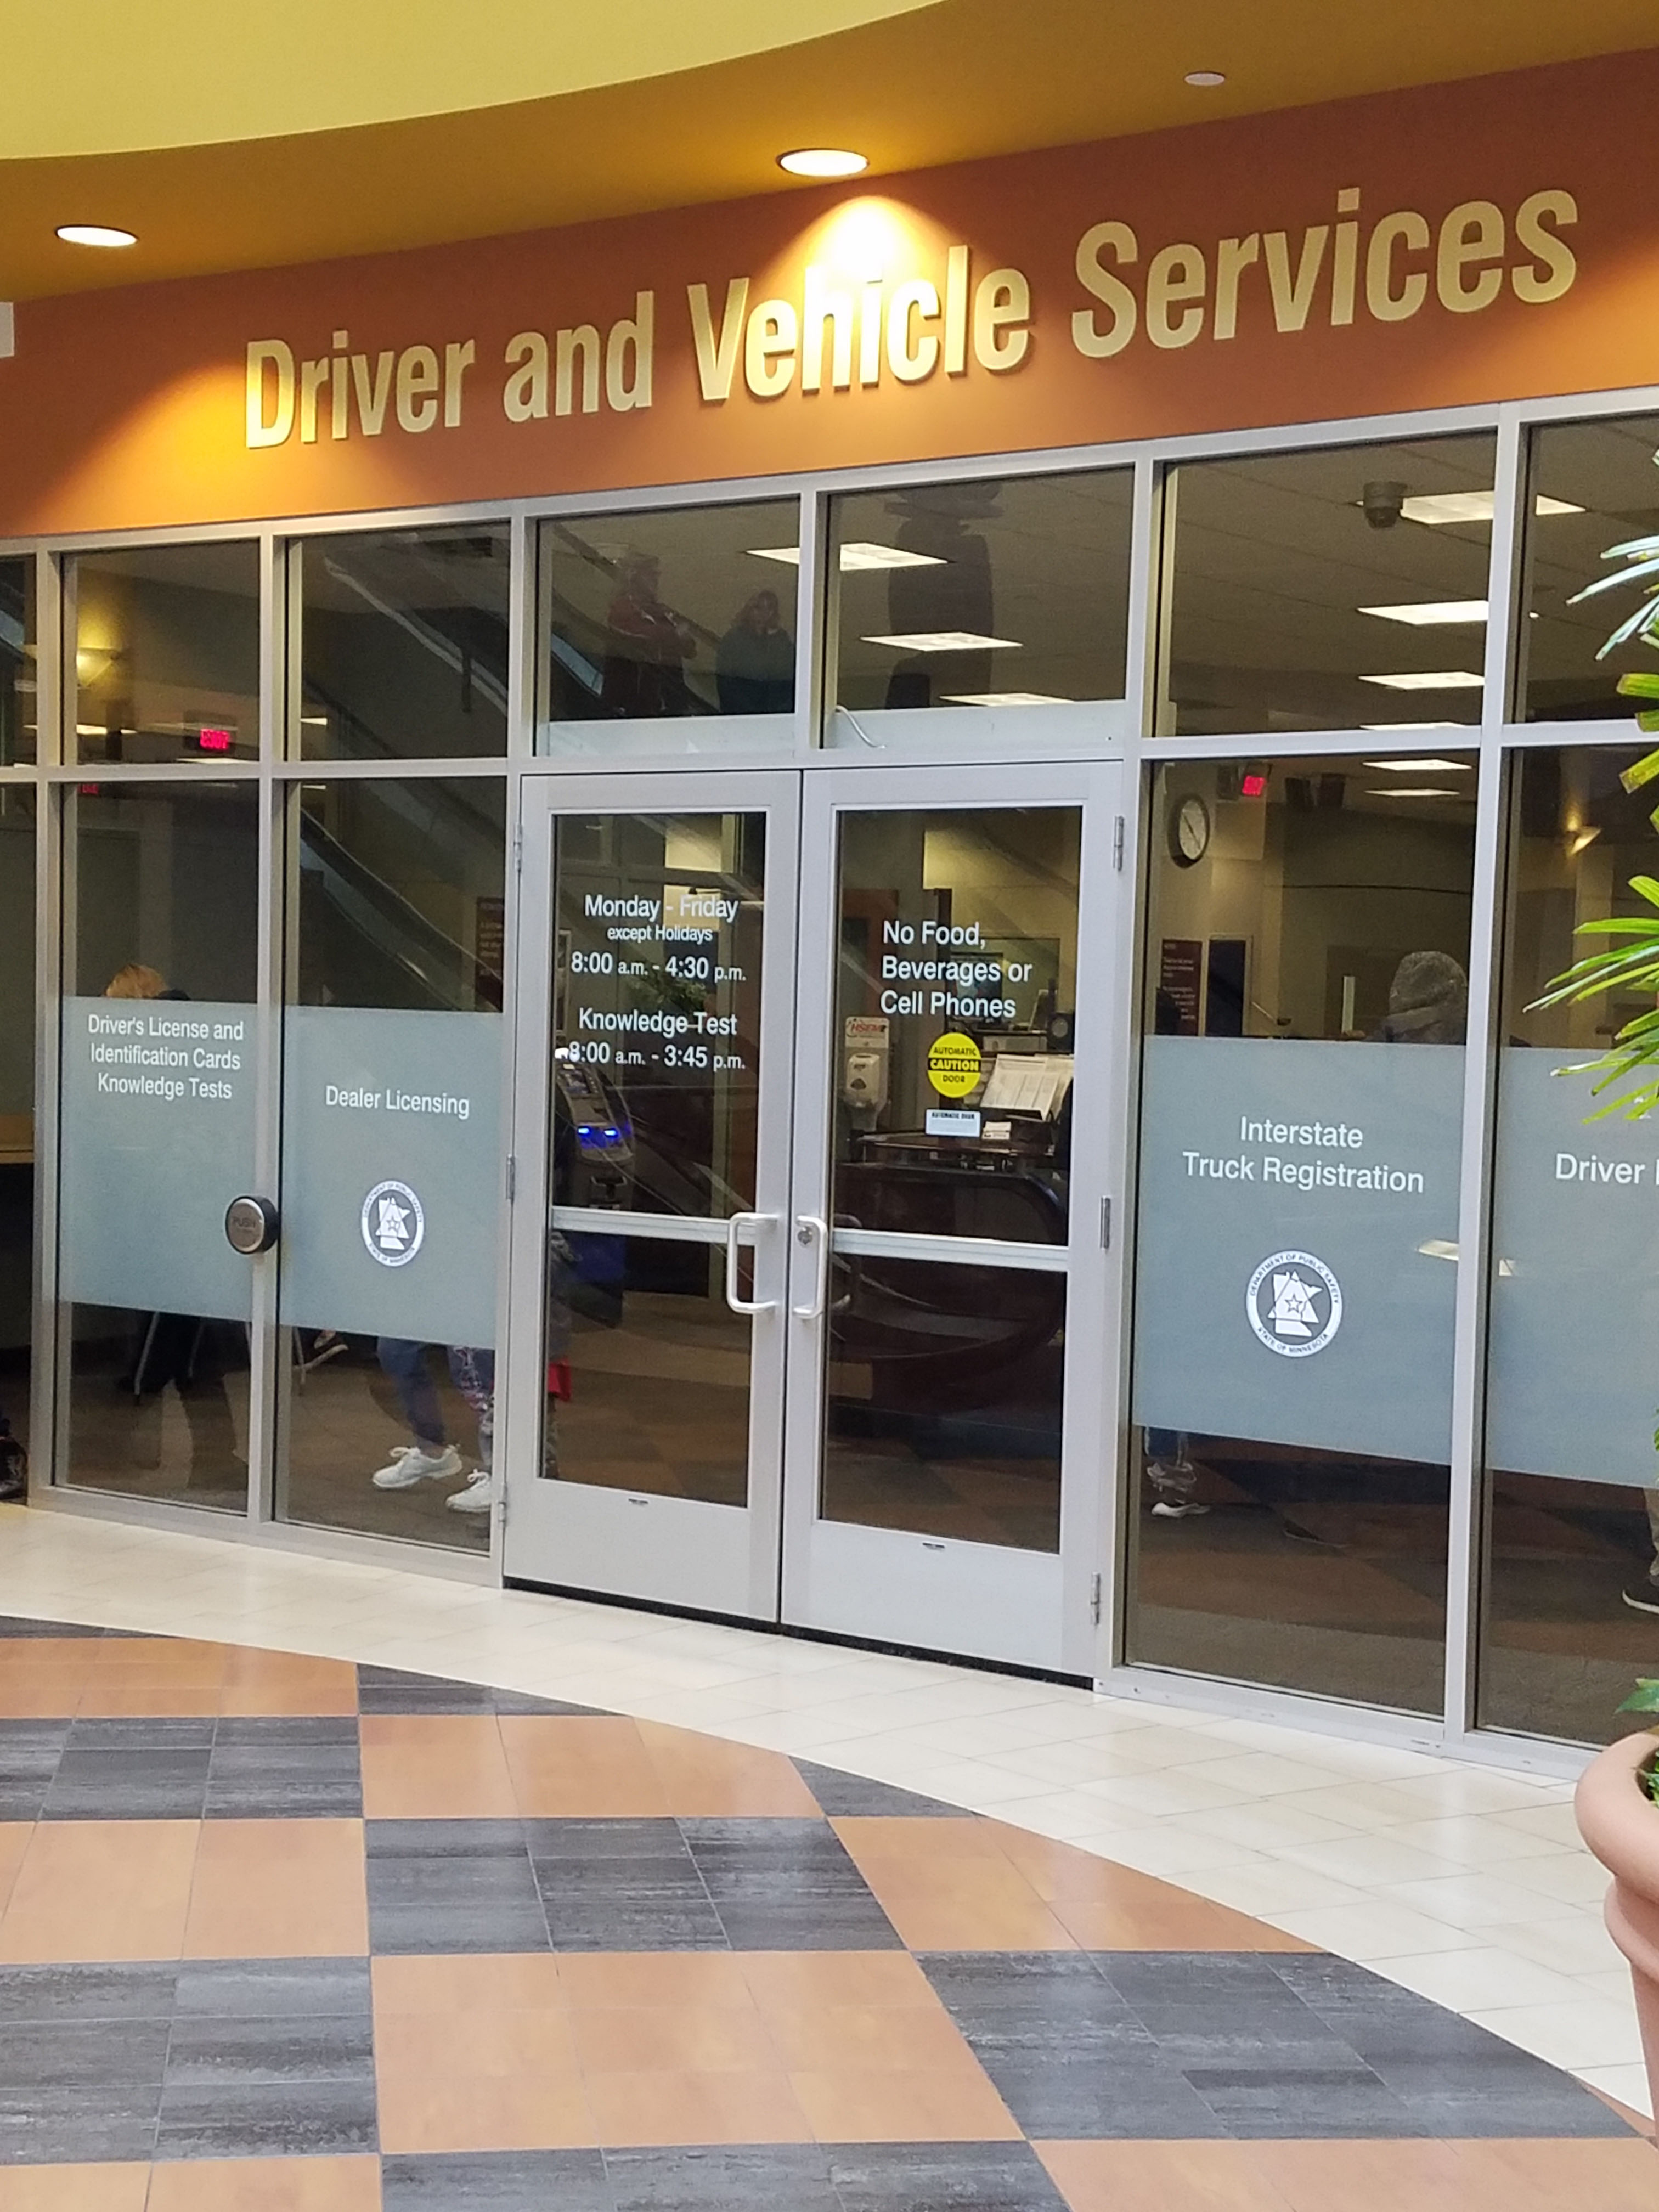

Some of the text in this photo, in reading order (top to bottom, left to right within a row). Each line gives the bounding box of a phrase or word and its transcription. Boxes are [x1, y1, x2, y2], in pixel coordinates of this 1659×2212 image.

[246, 187, 1578, 449] Driver and Vehicle Services
[585, 894, 661, 922] Monday
[680, 894, 738, 923] Friday
[607, 924, 713, 945] except Holidays
[883, 920, 985, 950] No Food,
[571, 951, 613, 974] 8:00
[618, 961, 648, 975] a.m.
[665, 956, 709, 979] 4:30
[714, 966, 747, 983] p.m.
[882, 955, 1033, 986] Beverages or
[881, 990, 1016, 1018] Cell Phones
[88, 1014, 244, 1041] Driver's License and
[579, 1007, 738, 1039] Knowledge Test
[91, 1042, 241, 1070] Identification Cards
[569, 1041, 610, 1064] 8:00
[615, 1051, 646, 1065] a.m.
[664, 1044, 708, 1067] 3:45
[713, 1054, 746, 1072] p.m.
[930, 1059, 979, 1071] CAUTION
[933, 1047, 977, 1056] AUTOMATIC
[98, 1073, 232, 1101] Knowledge Tests
[943, 1075, 966, 1083] DOOR
[326, 1085, 469, 1120] Dealer Licensing
[1240, 1116, 1363, 1148] Interstate
[1182, 1151, 1424, 1193] Truck Registration
[1556, 1153, 1645, 1184] Driver
[1250, 1255, 1284, 1296] DEPARTMENT
[1299, 1255, 1324, 1273] PUBLIC
